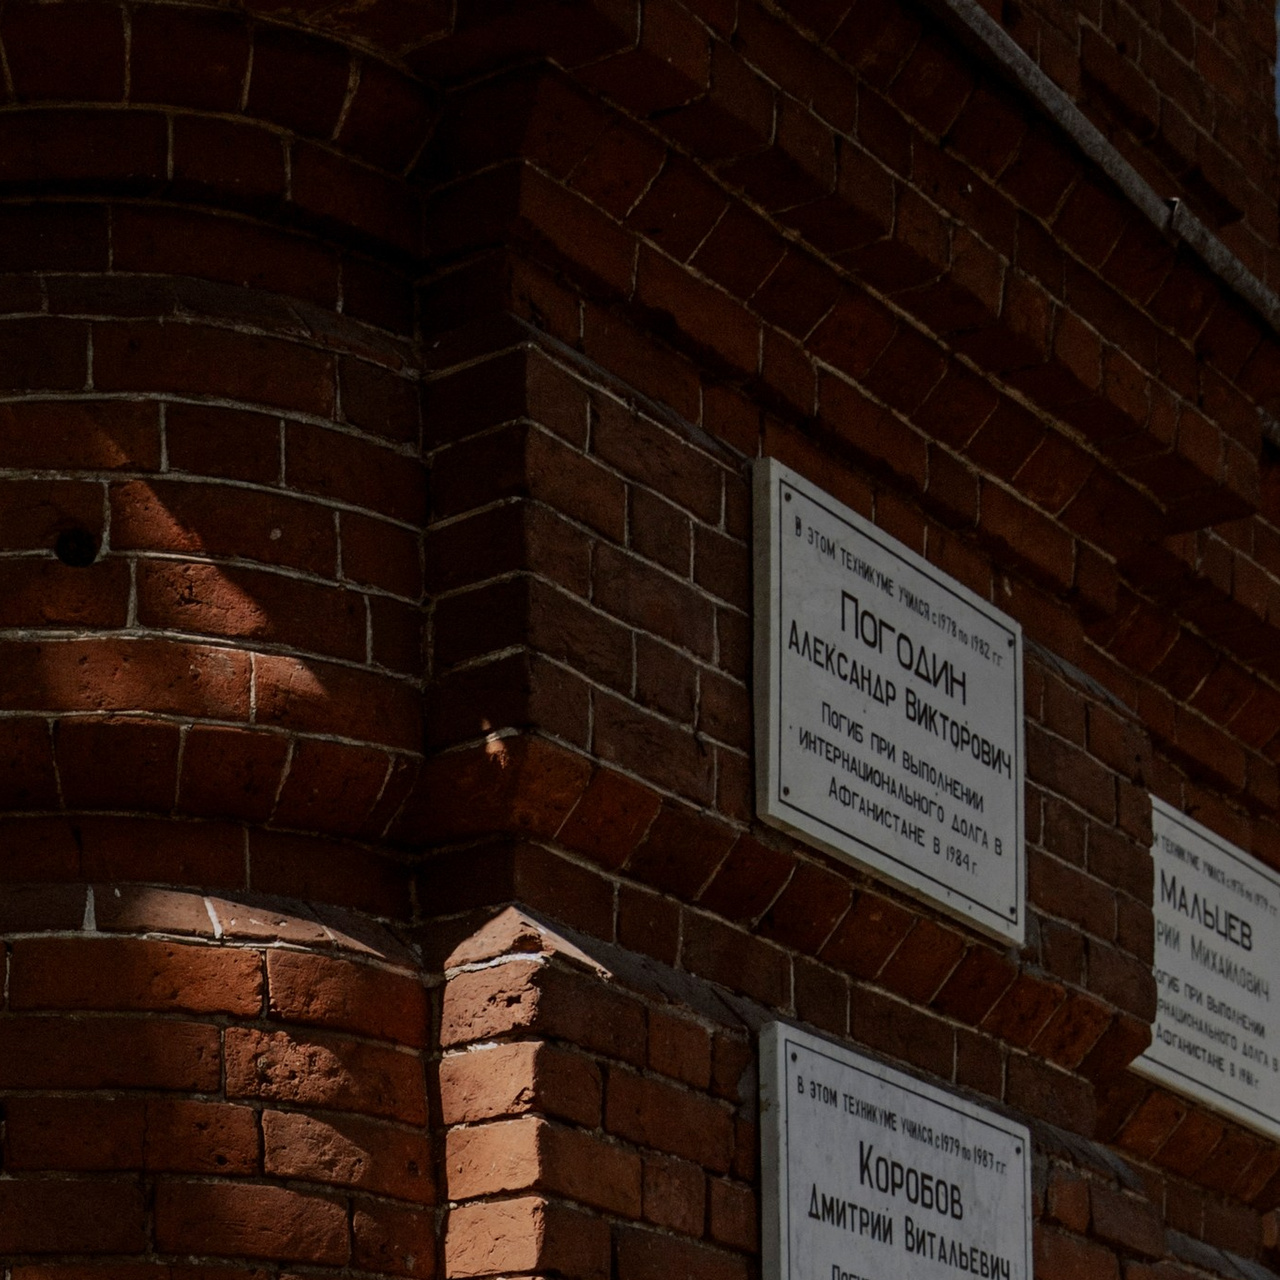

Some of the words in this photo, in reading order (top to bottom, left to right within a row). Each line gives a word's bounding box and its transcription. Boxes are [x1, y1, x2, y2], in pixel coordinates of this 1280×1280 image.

[795, 515, 802, 537] В
[808, 527, 835, 559] ЭТОМ
[840, 548, 894, 598] ТЕХНИКУМЕ
[898, 584, 930, 622] УЧИЛСЯ
[970, 634, 991, 660] 1982
[841, 589, 967, 707] ПОГОДИН
[788, 619, 897, 708] АЛЕКСАНДР
[905, 686, 1012, 780] ВИКТОРОВИЧ
[799, 726, 945, 823] ИНТЕРНАЦИОНАЛЬНОГО
[951, 813, 989, 850] ДОЛГА
[994, 837, 1003, 856] В
[821, 700, 864, 744] ПОГИБ
[870, 731, 895, 763] ПРИ
[902, 750, 984, 813] ВЫПОЛНЕНИИ
[828, 776, 926, 848] АФГАНИСТАНЕ
[933, 836, 940, 855] В
[1160, 868, 1253, 952] МАЛЬЦЕВ
[1154, 965, 1180, 994] ОГИБ
[1184, 983, 1203, 1006] ПРИ
[1206, 995, 1266, 1039] ВЫПОЛНЕНИИ
[1190, 935, 1270, 1003] МИХАЙЛОВИЧ
[1156, 1022, 1225, 1073] АФГАНИСТАНЕ
[1272, 1057, 1279, 1073] В
[797, 1075, 805, 1095] В
[809, 1080, 838, 1108] ЭТОМ
[843, 1093, 897, 1132] ТЕХНИКУМЕ
[901, 1117, 933, 1146] УЧИЛСЯ
[808, 1182, 894, 1246] ДМИТРИЙ
[858, 1140, 964, 1221] КОРОБОВ
